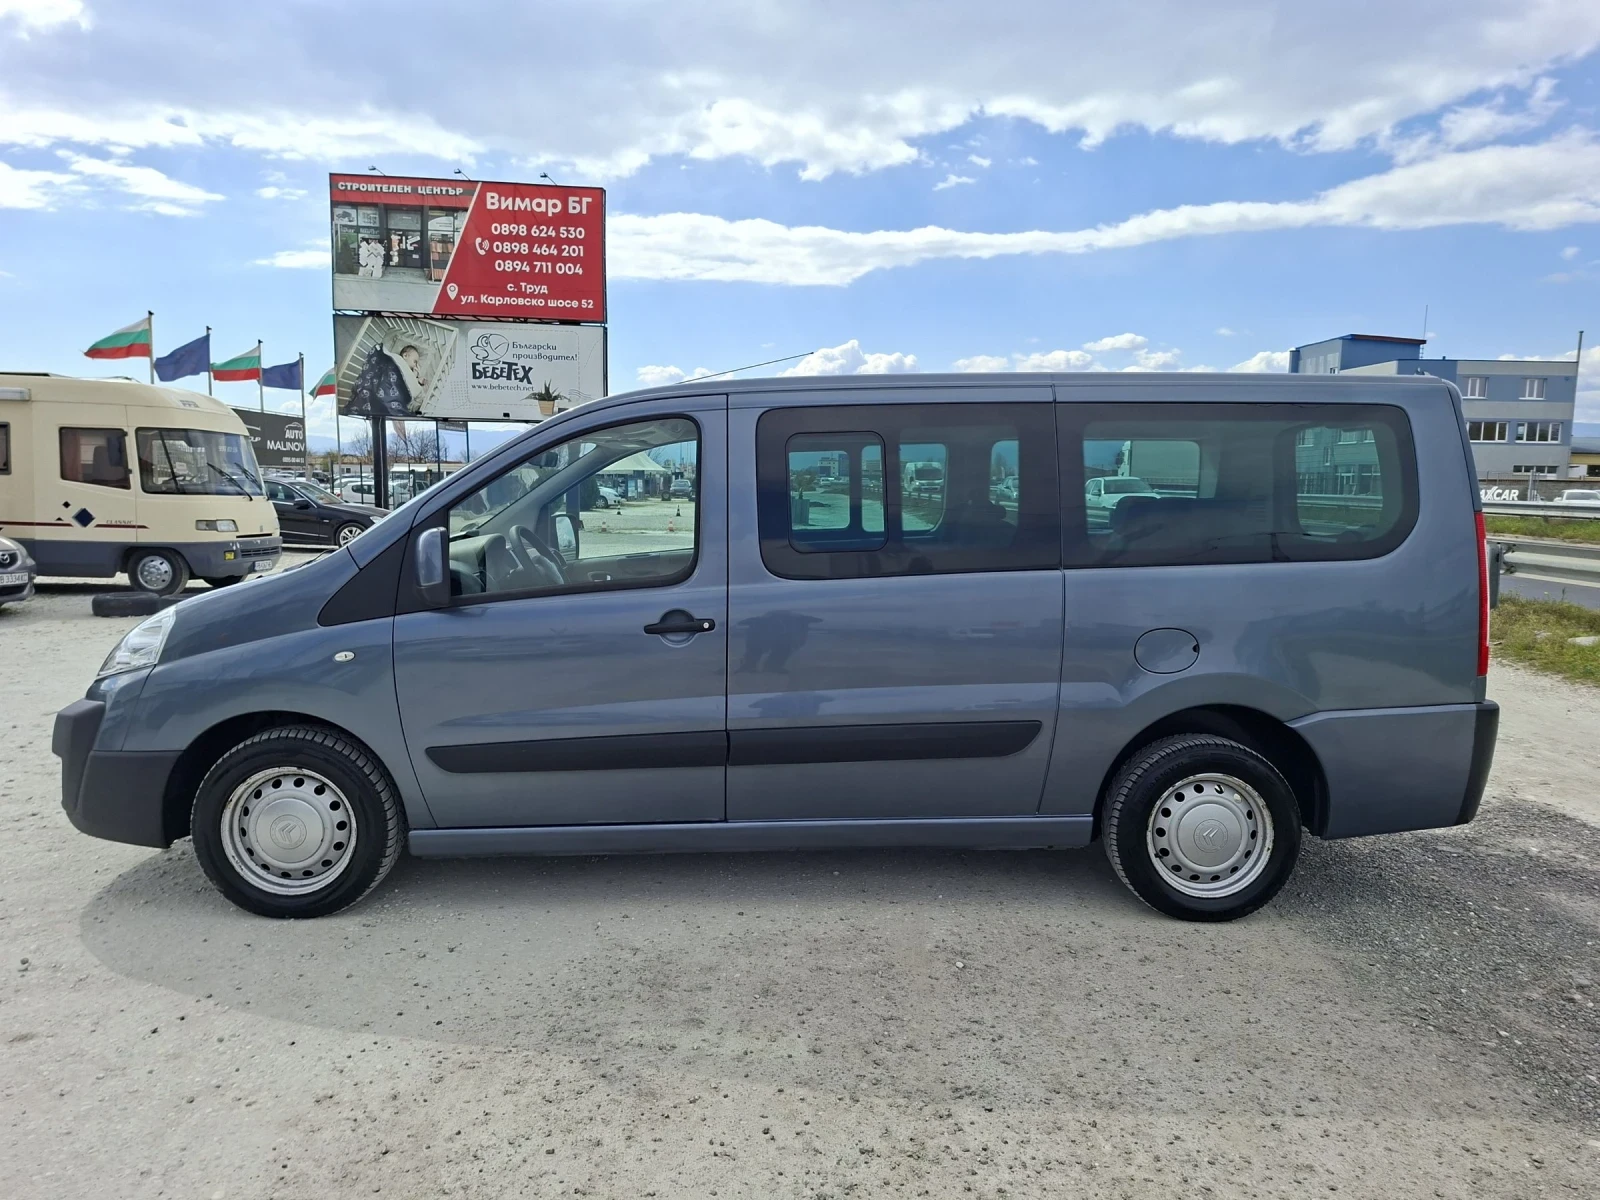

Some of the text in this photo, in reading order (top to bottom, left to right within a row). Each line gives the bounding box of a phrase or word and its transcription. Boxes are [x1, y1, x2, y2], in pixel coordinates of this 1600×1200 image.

[338, 182, 463, 195] СТРОИТЕЛЕН ЦЕНТЪР
[486, 192, 592, 216] Вимар БГ
[491, 223, 585, 239] 0898 624 530
[493, 241, 584, 257] 0898 464 201
[495, 260, 583, 275] 0894 711 004
[520, 282, 548, 295] Труд
[460, 295, 594, 309] ул. Карловско шосе 52
[512, 341, 557, 351] Български
[512, 352, 578, 361] производител!
[471, 383, 535, 392] www.bebetech.net
[285, 429, 304, 440] AUTO
[266, 440, 305, 452] MALINOV
